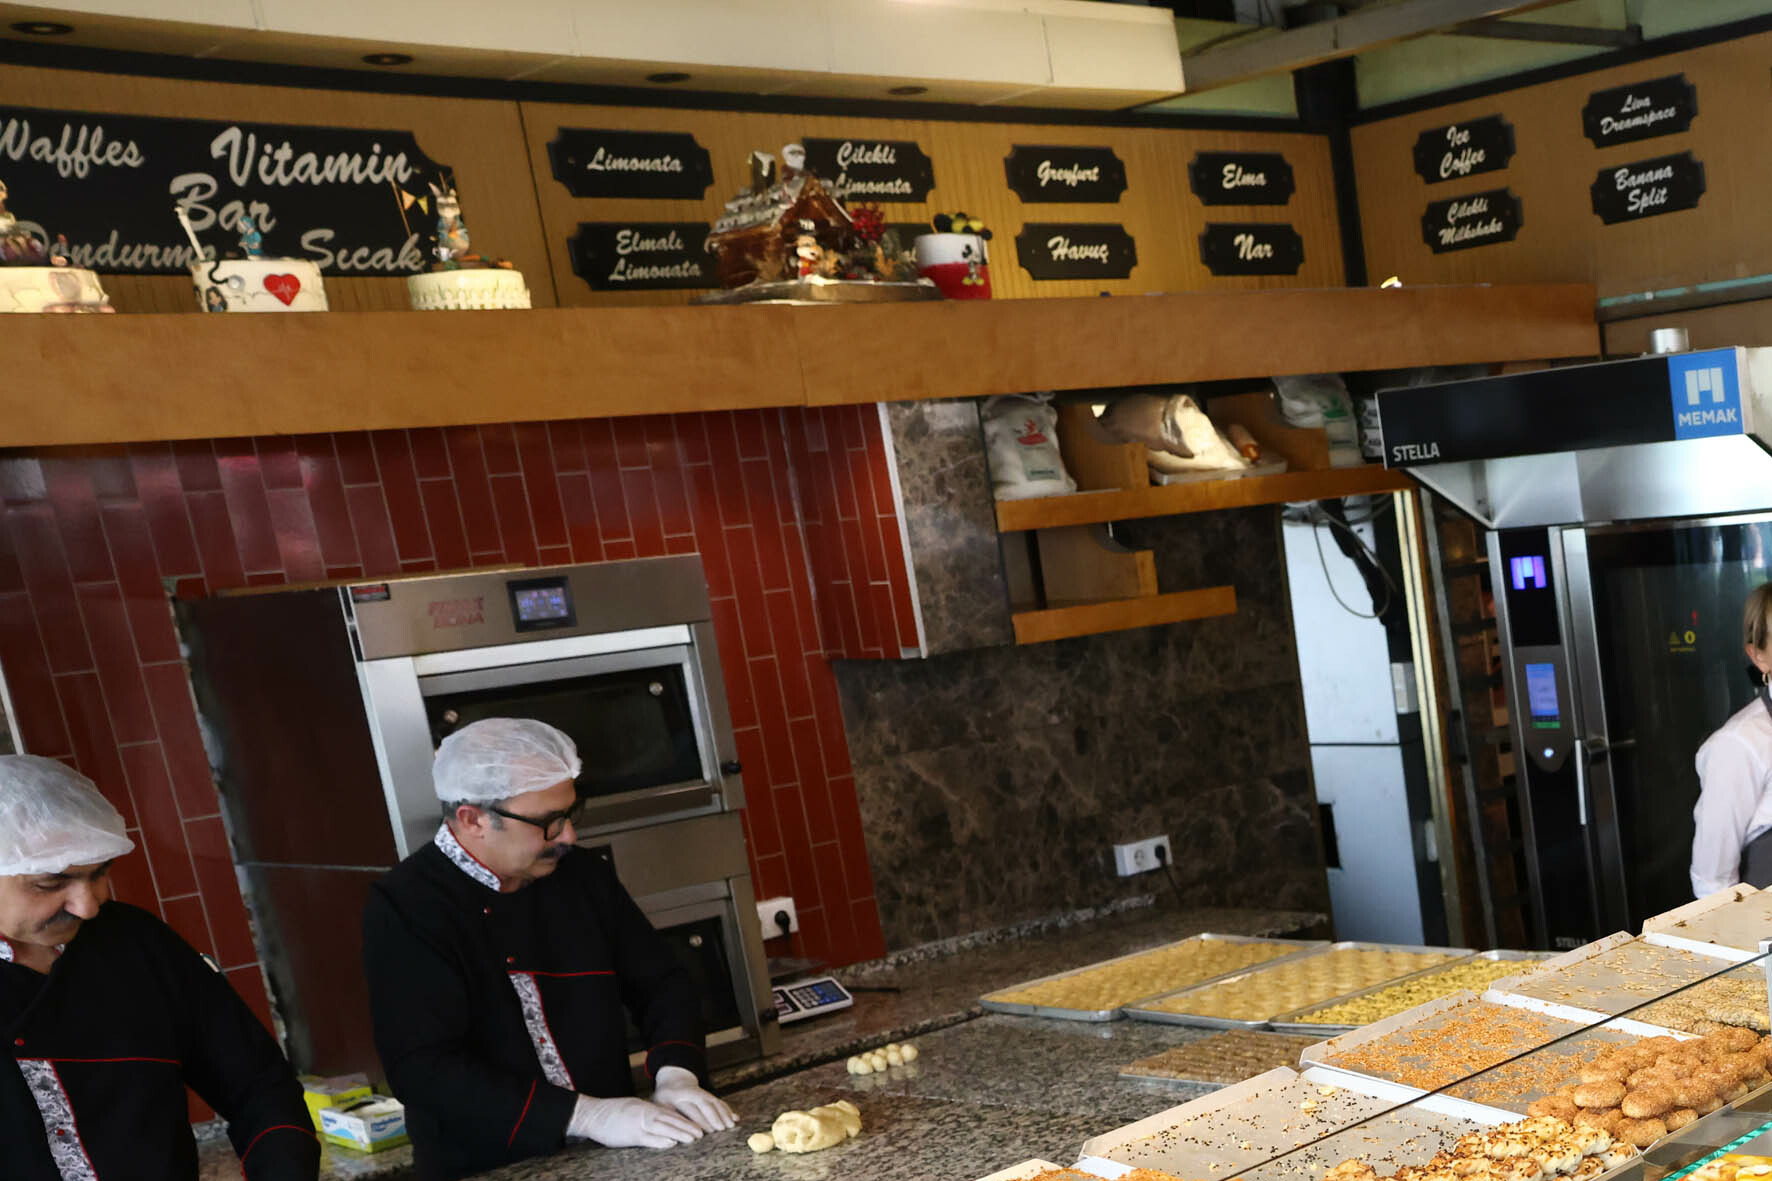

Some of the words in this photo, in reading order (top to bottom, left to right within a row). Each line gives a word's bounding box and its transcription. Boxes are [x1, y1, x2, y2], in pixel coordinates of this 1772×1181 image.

[1620, 94, 1651, 114] Liva
[0, 118, 145, 179] Waffles
[1446, 126, 1470, 148] Ice
[211, 126, 413, 188] Vitamin
[587, 147, 684, 173] Limonata
[837, 141, 896, 171] Çilekli
[1439, 149, 1485, 178] Coffee
[1037, 160, 1099, 187] Greyfurt
[1222, 164, 1266, 189] Elma
[1614, 164, 1673, 190] Banana
[169, 173, 276, 233] Bar
[1627, 187, 1668, 214] Split
[301, 229, 426, 272] Sıcak
[616, 230, 684, 254] Elmalı
[1048, 236, 1109, 264] Havuç
[1234, 234, 1273, 260] Nar
[608, 257, 702, 282] Limonata
[1678, 407, 1738, 427] MEMAK
[1392, 442, 1440, 462] STELLA
